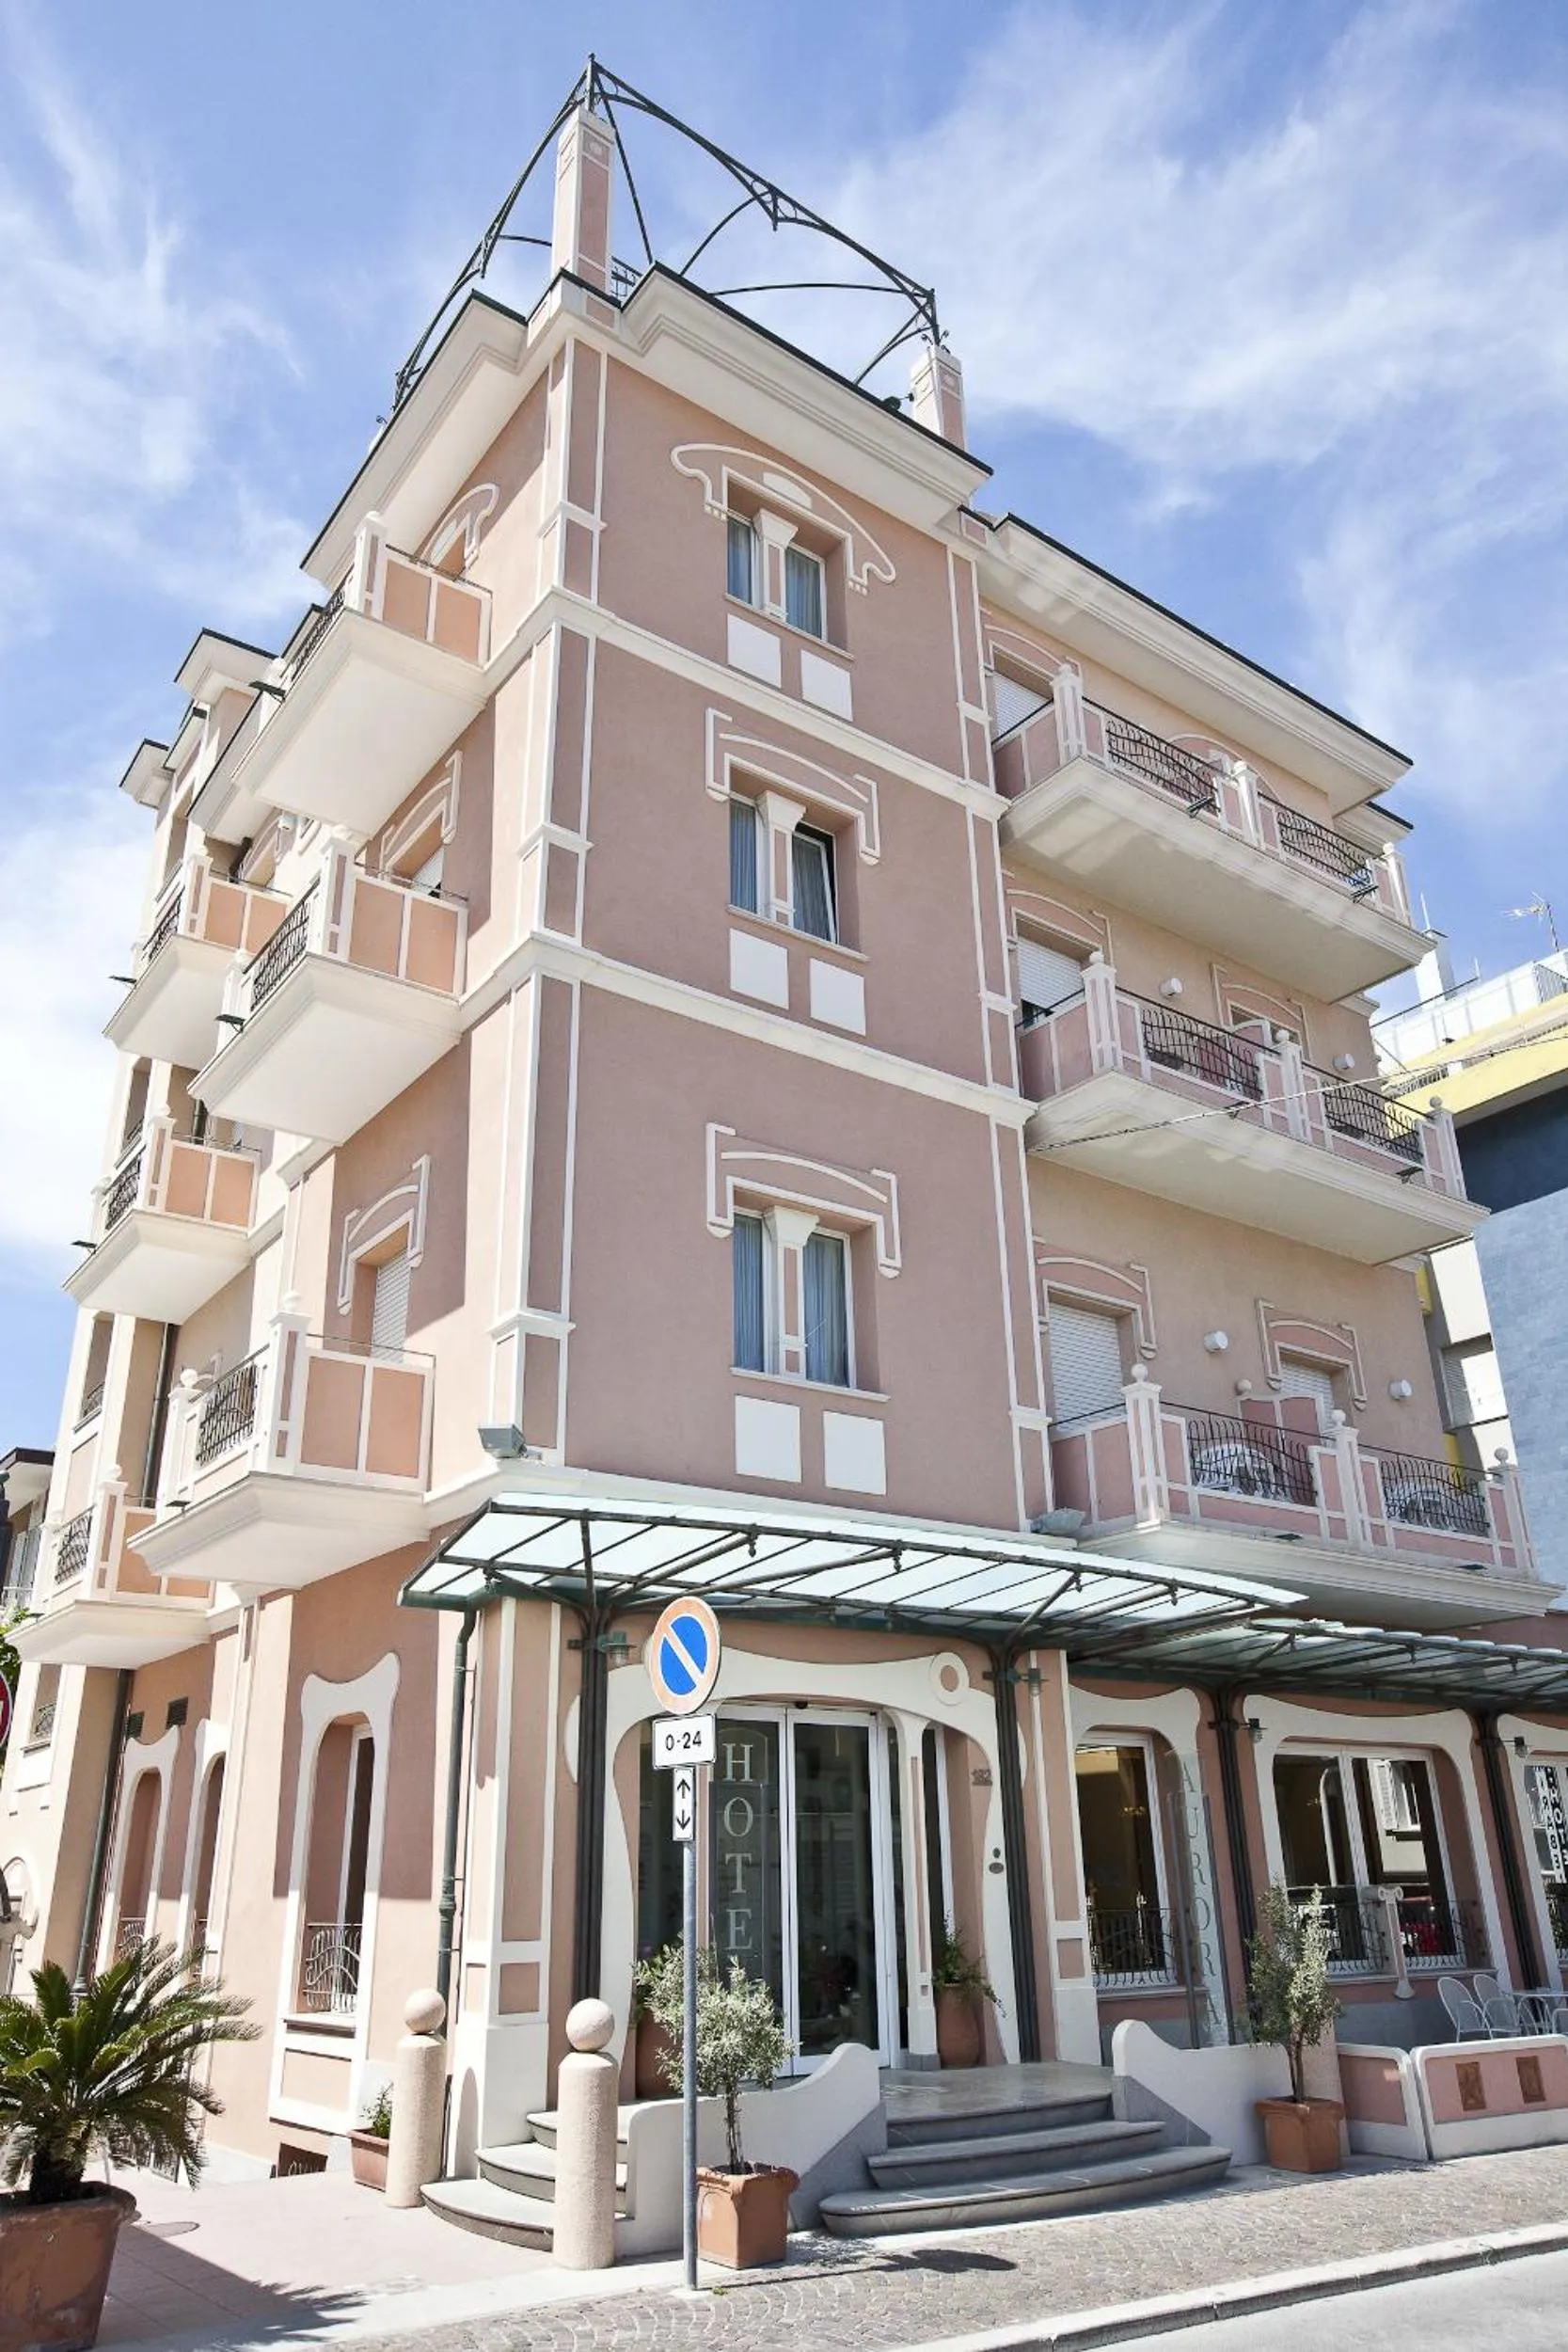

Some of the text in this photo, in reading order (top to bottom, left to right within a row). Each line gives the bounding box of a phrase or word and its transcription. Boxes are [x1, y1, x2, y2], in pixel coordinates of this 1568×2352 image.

[665, 1731, 702, 1751] 0-24
[722, 1743, 754, 1951] HOTE
[1180, 1760, 1222, 2026] AURORA
